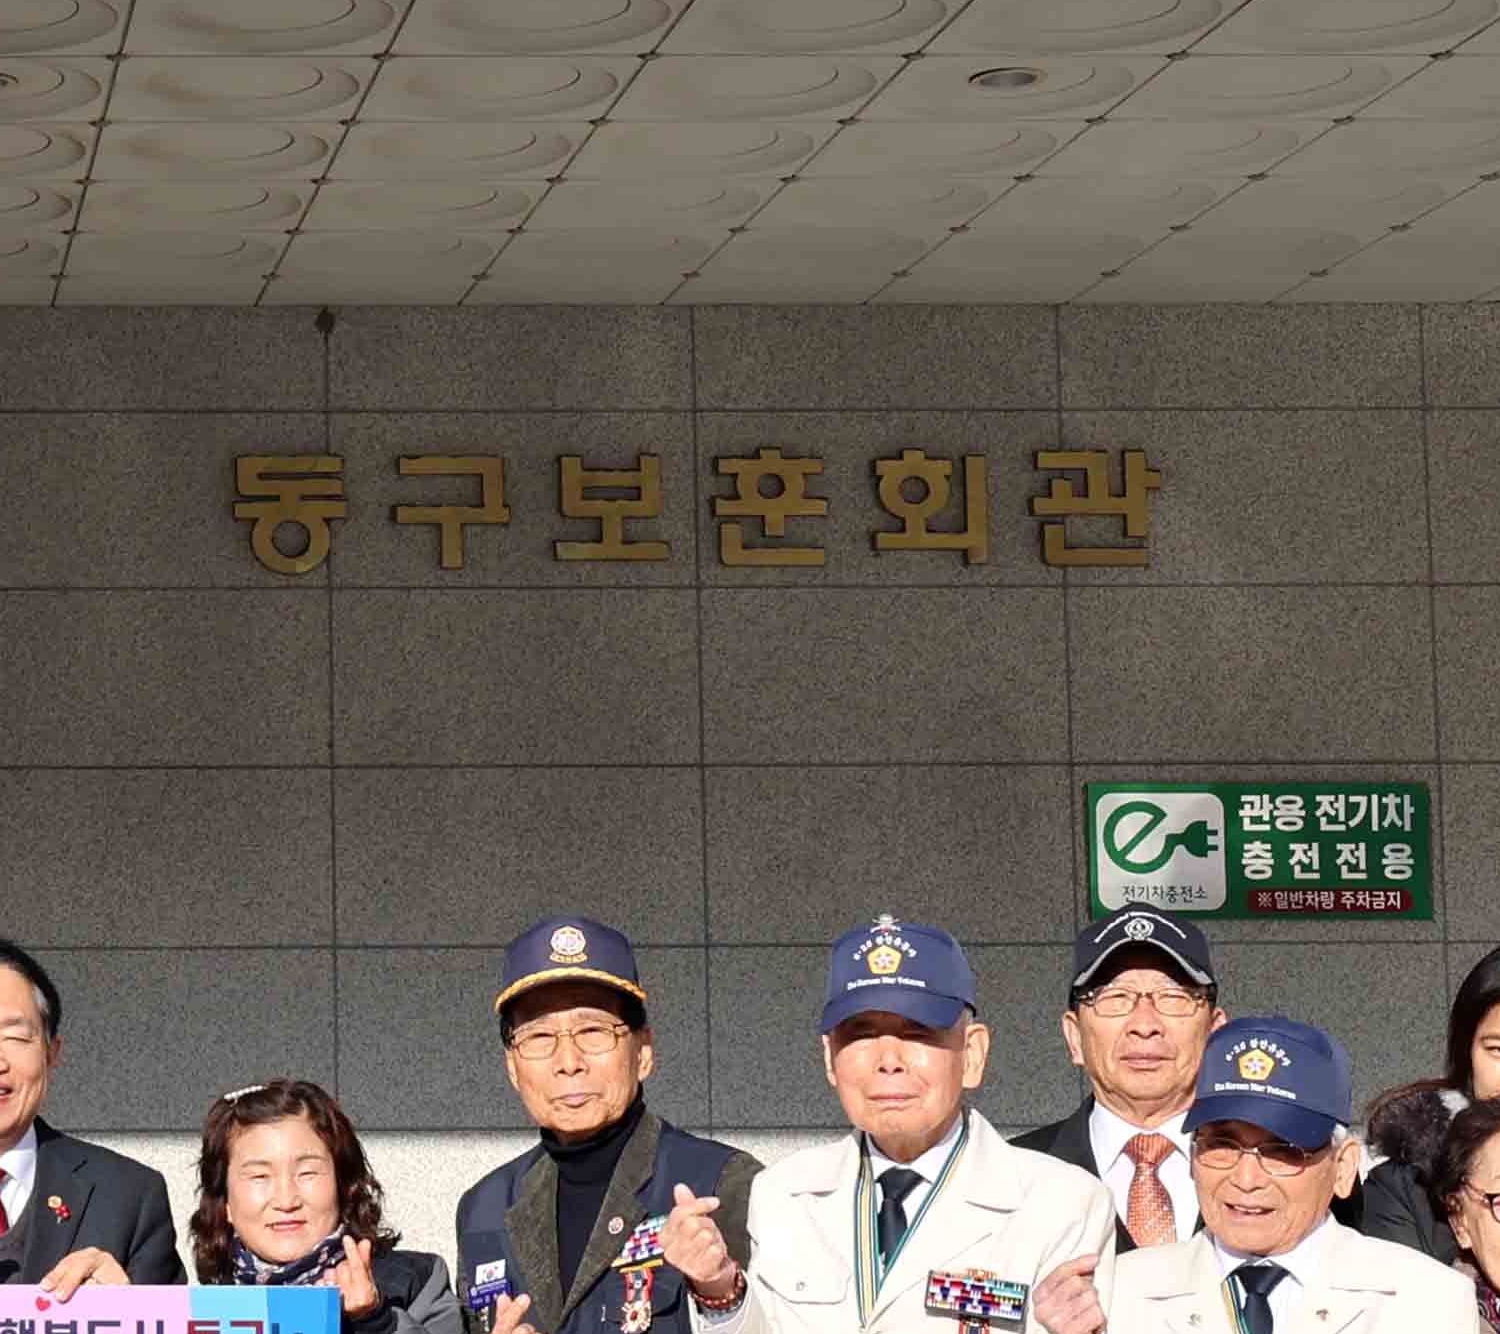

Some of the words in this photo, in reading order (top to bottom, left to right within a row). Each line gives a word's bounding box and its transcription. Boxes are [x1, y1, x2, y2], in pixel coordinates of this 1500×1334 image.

[1238, 793, 1307, 833] 관용
[1315, 793, 1416, 833] 전기차
[1121, 884, 1209, 904] 전기차충전소
[1340, 890, 1402, 910] 주차금지
